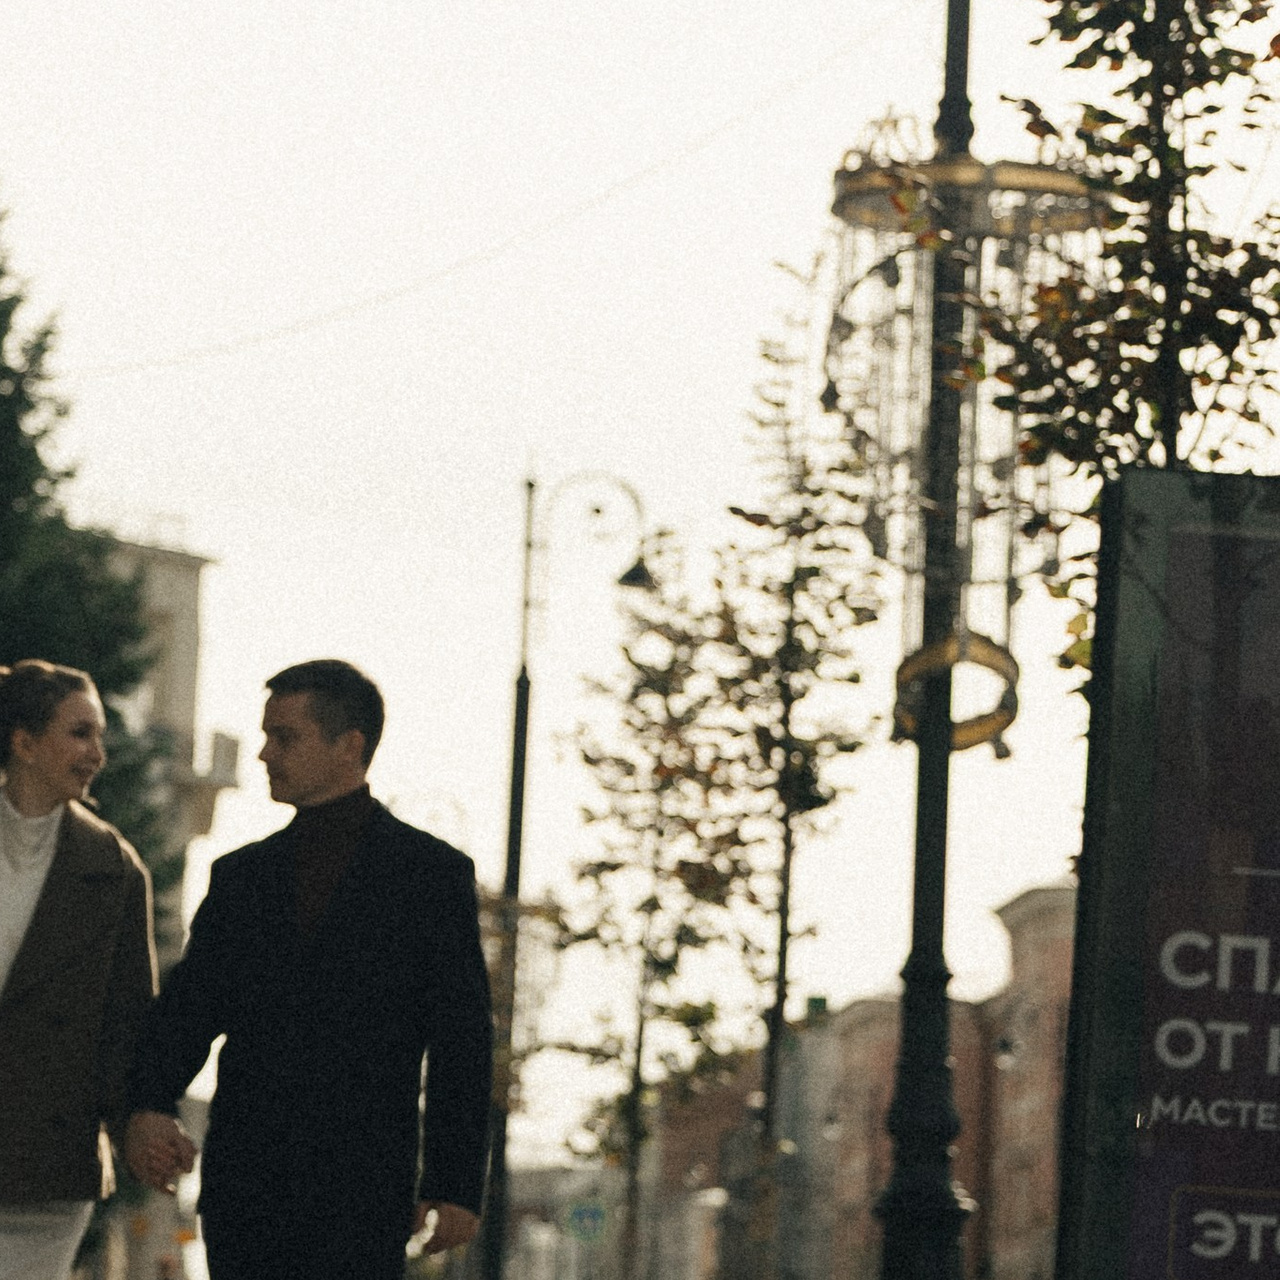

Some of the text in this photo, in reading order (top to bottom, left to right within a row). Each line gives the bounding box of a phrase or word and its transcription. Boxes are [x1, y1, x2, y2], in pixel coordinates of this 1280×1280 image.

[1159, 930, 1280, 995] СП
[1154, 1017, 1251, 1073] ОТ
[1190, 1209, 1280, 1263] ЭТ
